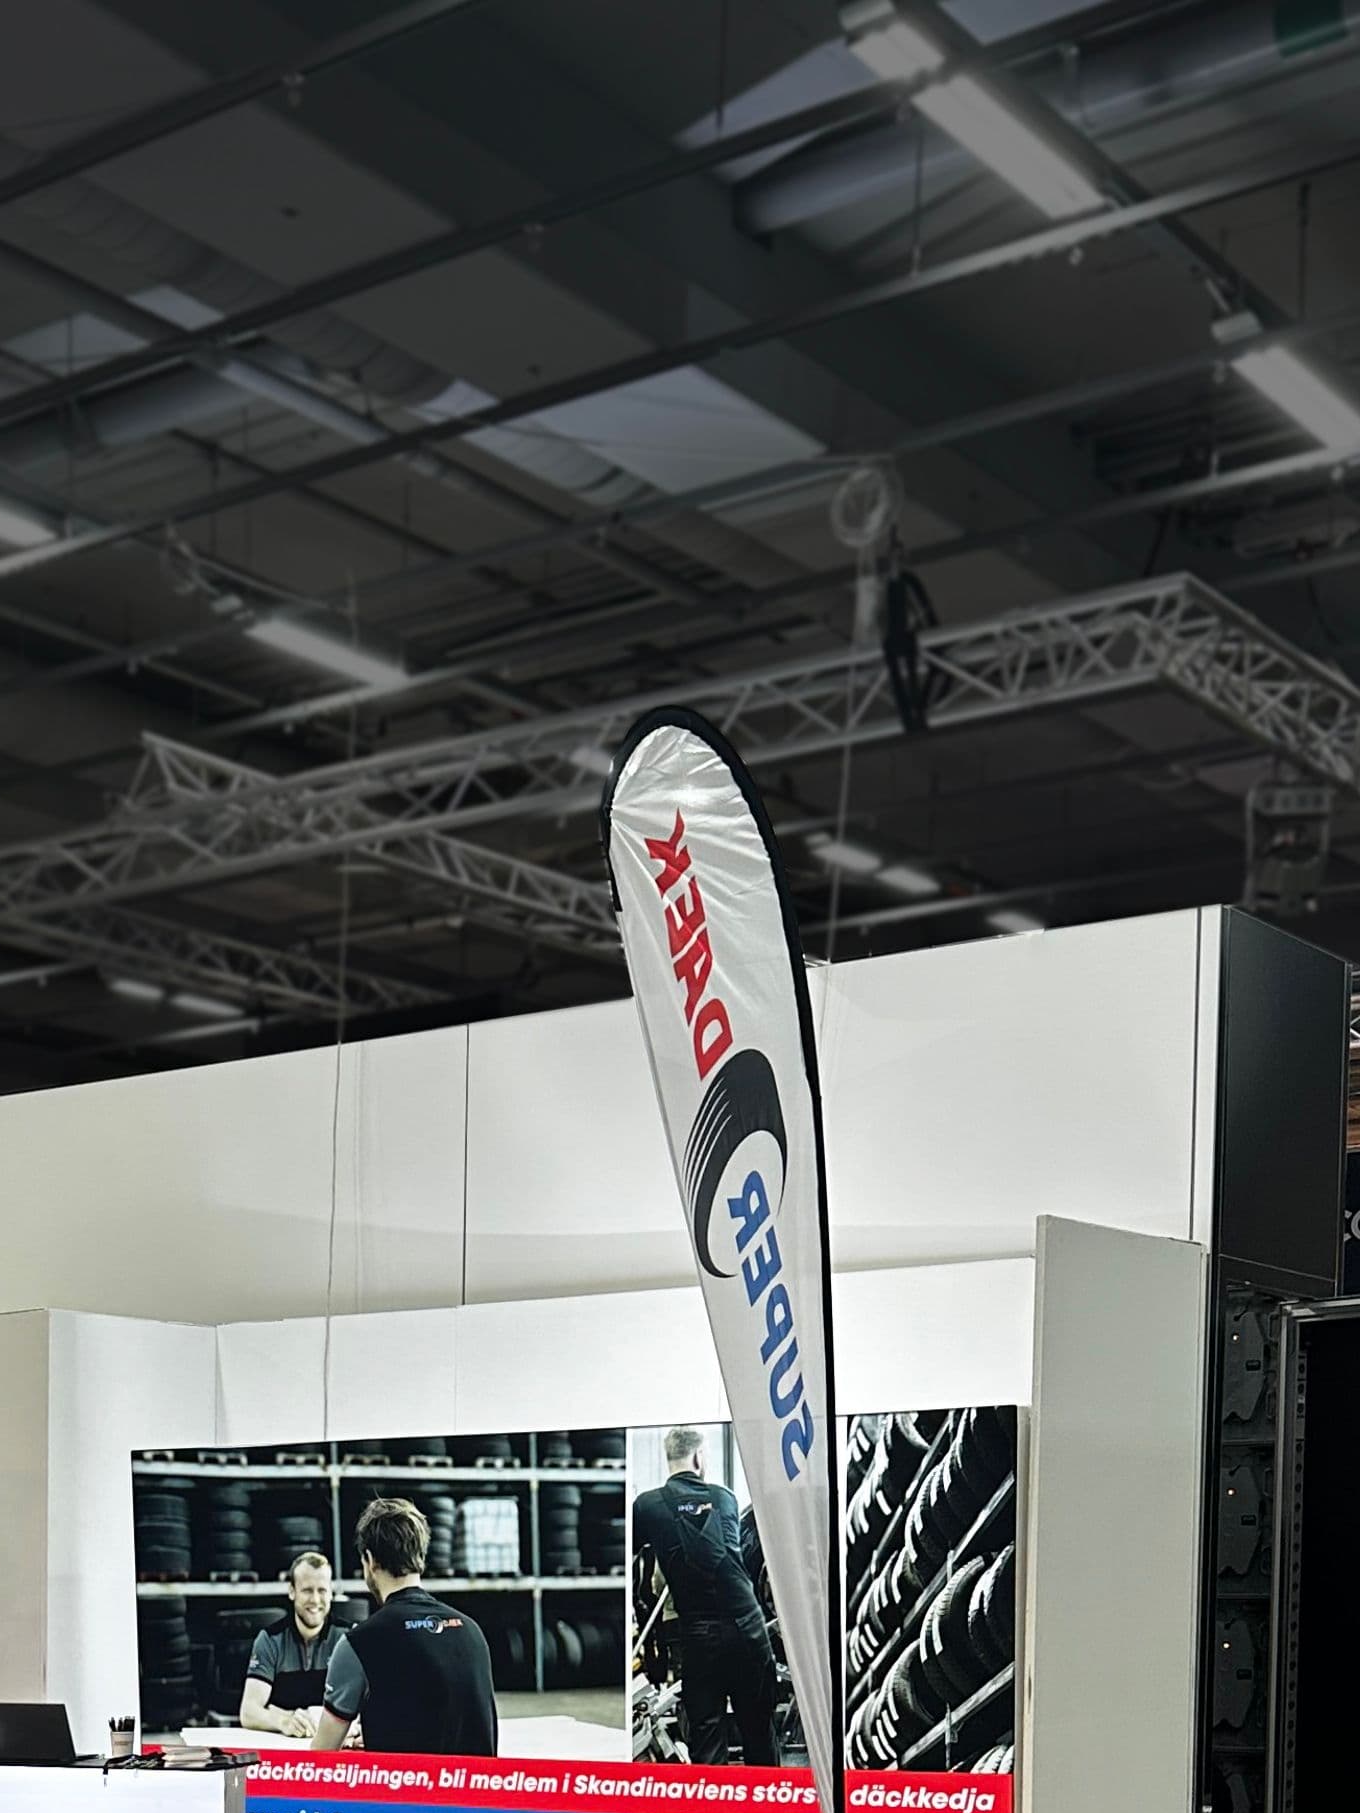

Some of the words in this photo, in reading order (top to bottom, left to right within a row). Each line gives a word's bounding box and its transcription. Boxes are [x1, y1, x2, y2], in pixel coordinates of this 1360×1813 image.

[246, 1761, 434, 1791] däckförsäljningen,
[439, 1767, 465, 1789] bli
[469, 1769, 557, 1794] medlem
[562, 1773, 571, 1794] i
[574, 1775, 746, 1805] Skandinaviens
[752, 1779, 822, 1806] störs
